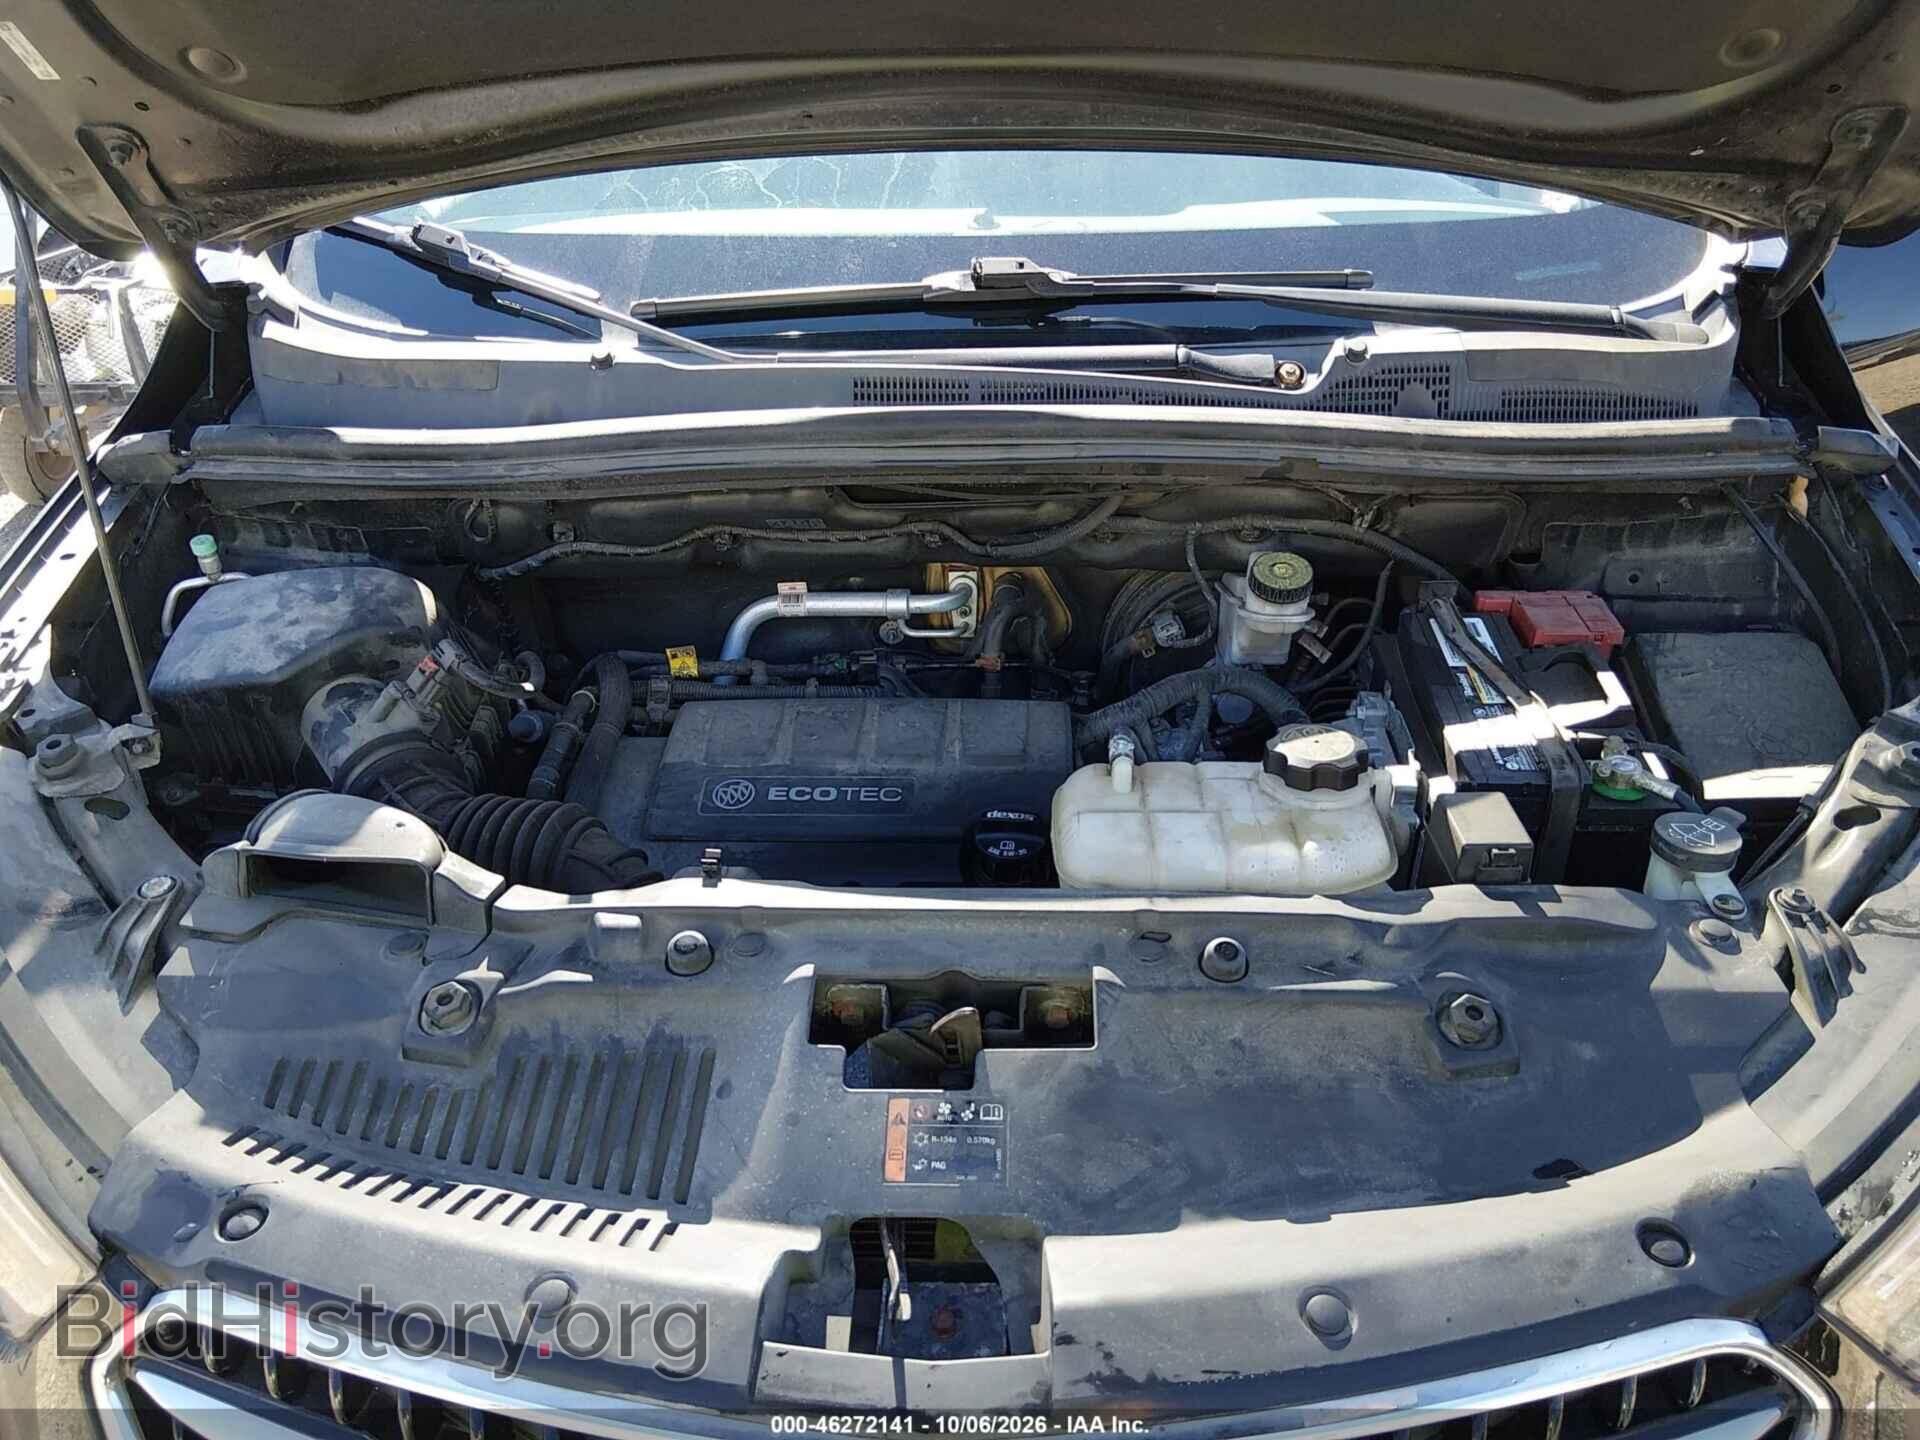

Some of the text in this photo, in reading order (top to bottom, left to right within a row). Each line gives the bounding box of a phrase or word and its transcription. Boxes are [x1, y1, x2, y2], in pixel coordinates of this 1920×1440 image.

[767, 786, 904, 802] ECOTEC
[986, 810, 1036, 822] dexos
[931, 1160, 947, 1170] PAG
